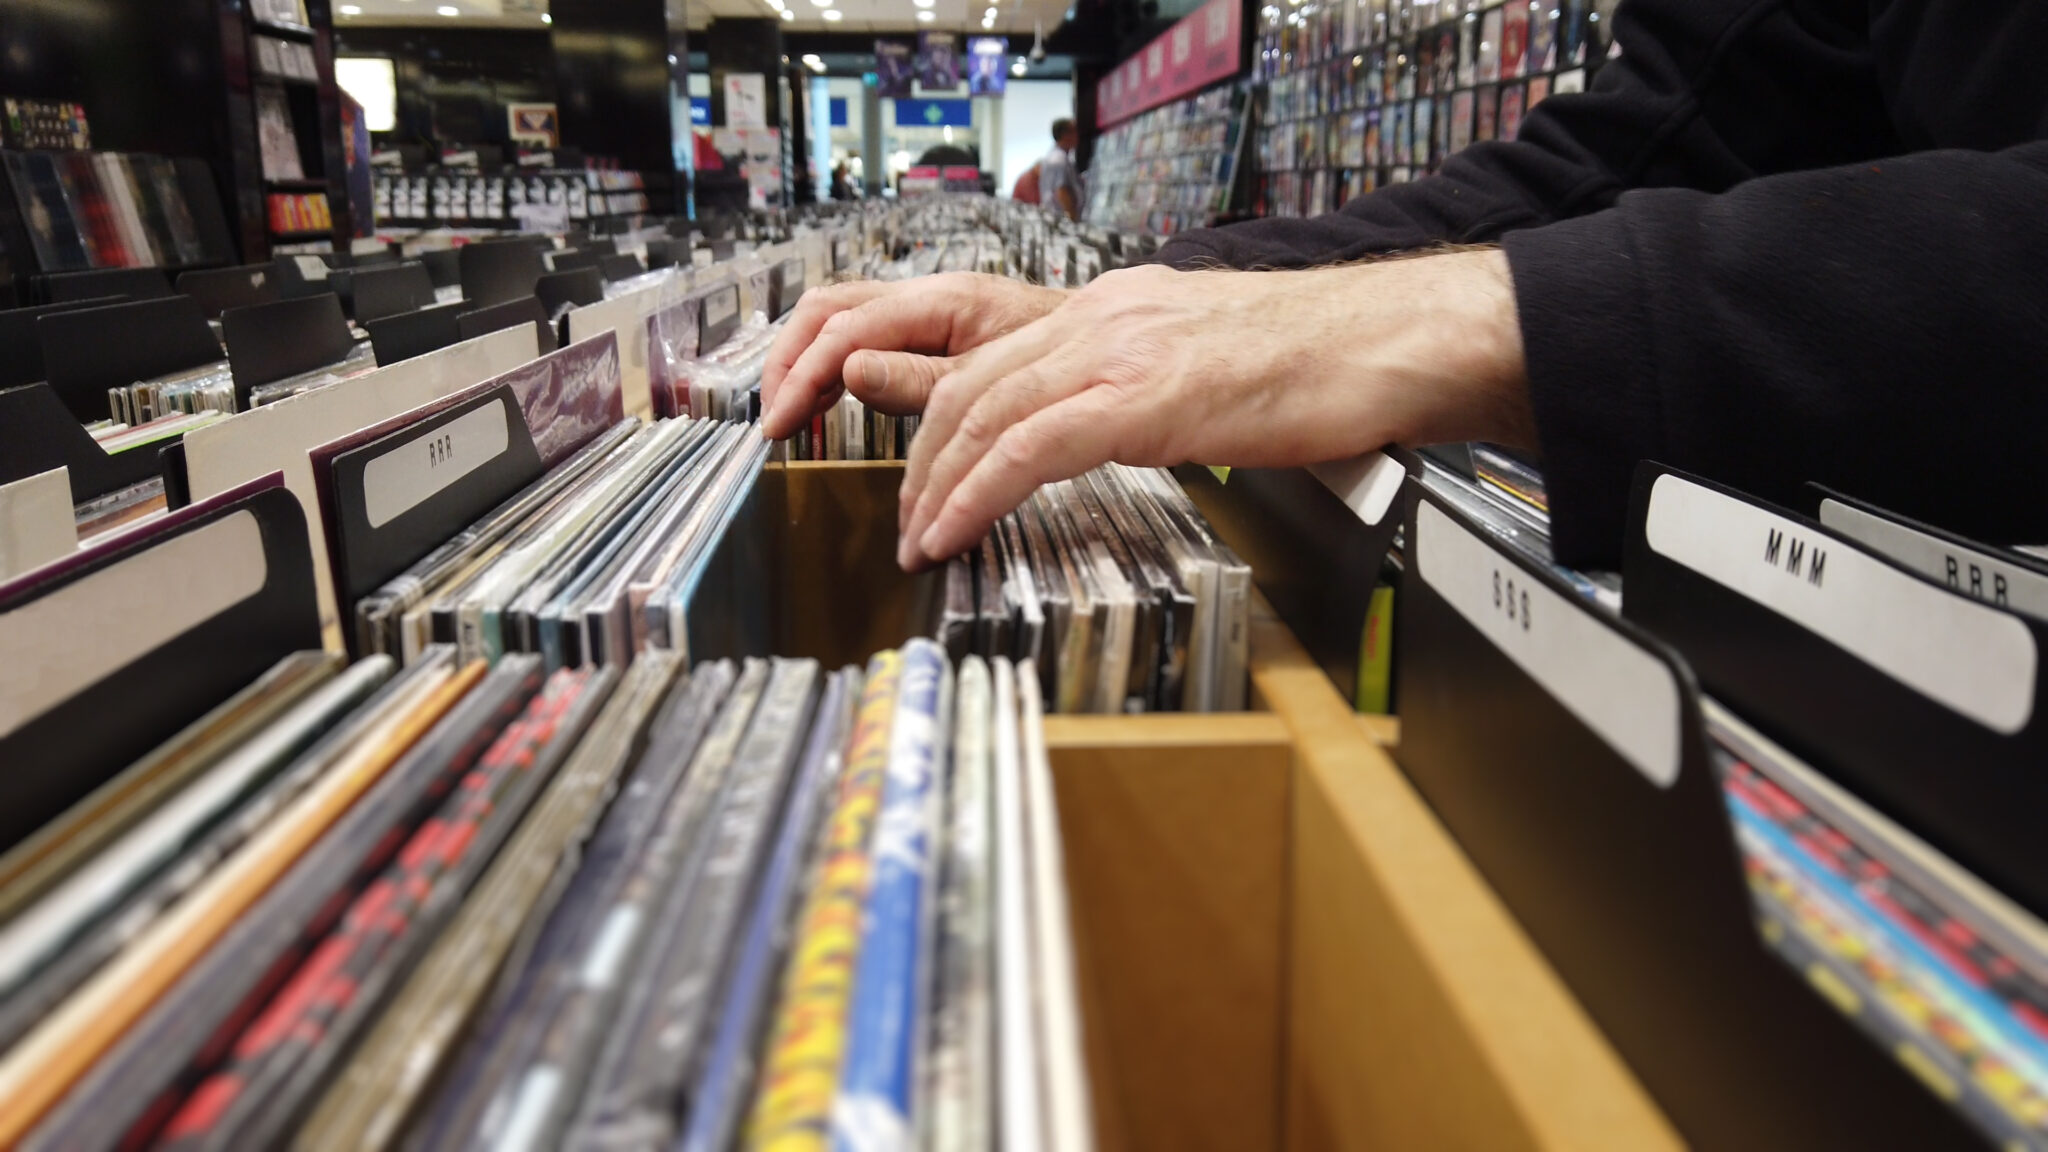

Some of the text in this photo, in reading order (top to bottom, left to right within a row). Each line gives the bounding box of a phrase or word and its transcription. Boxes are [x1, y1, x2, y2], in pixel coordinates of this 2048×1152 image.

[429, 434, 453, 468] RRR
[1764, 527, 1826, 589] MMM
[1945, 554, 2008, 606] RRR
[1492, 568, 1531, 632] SSS
